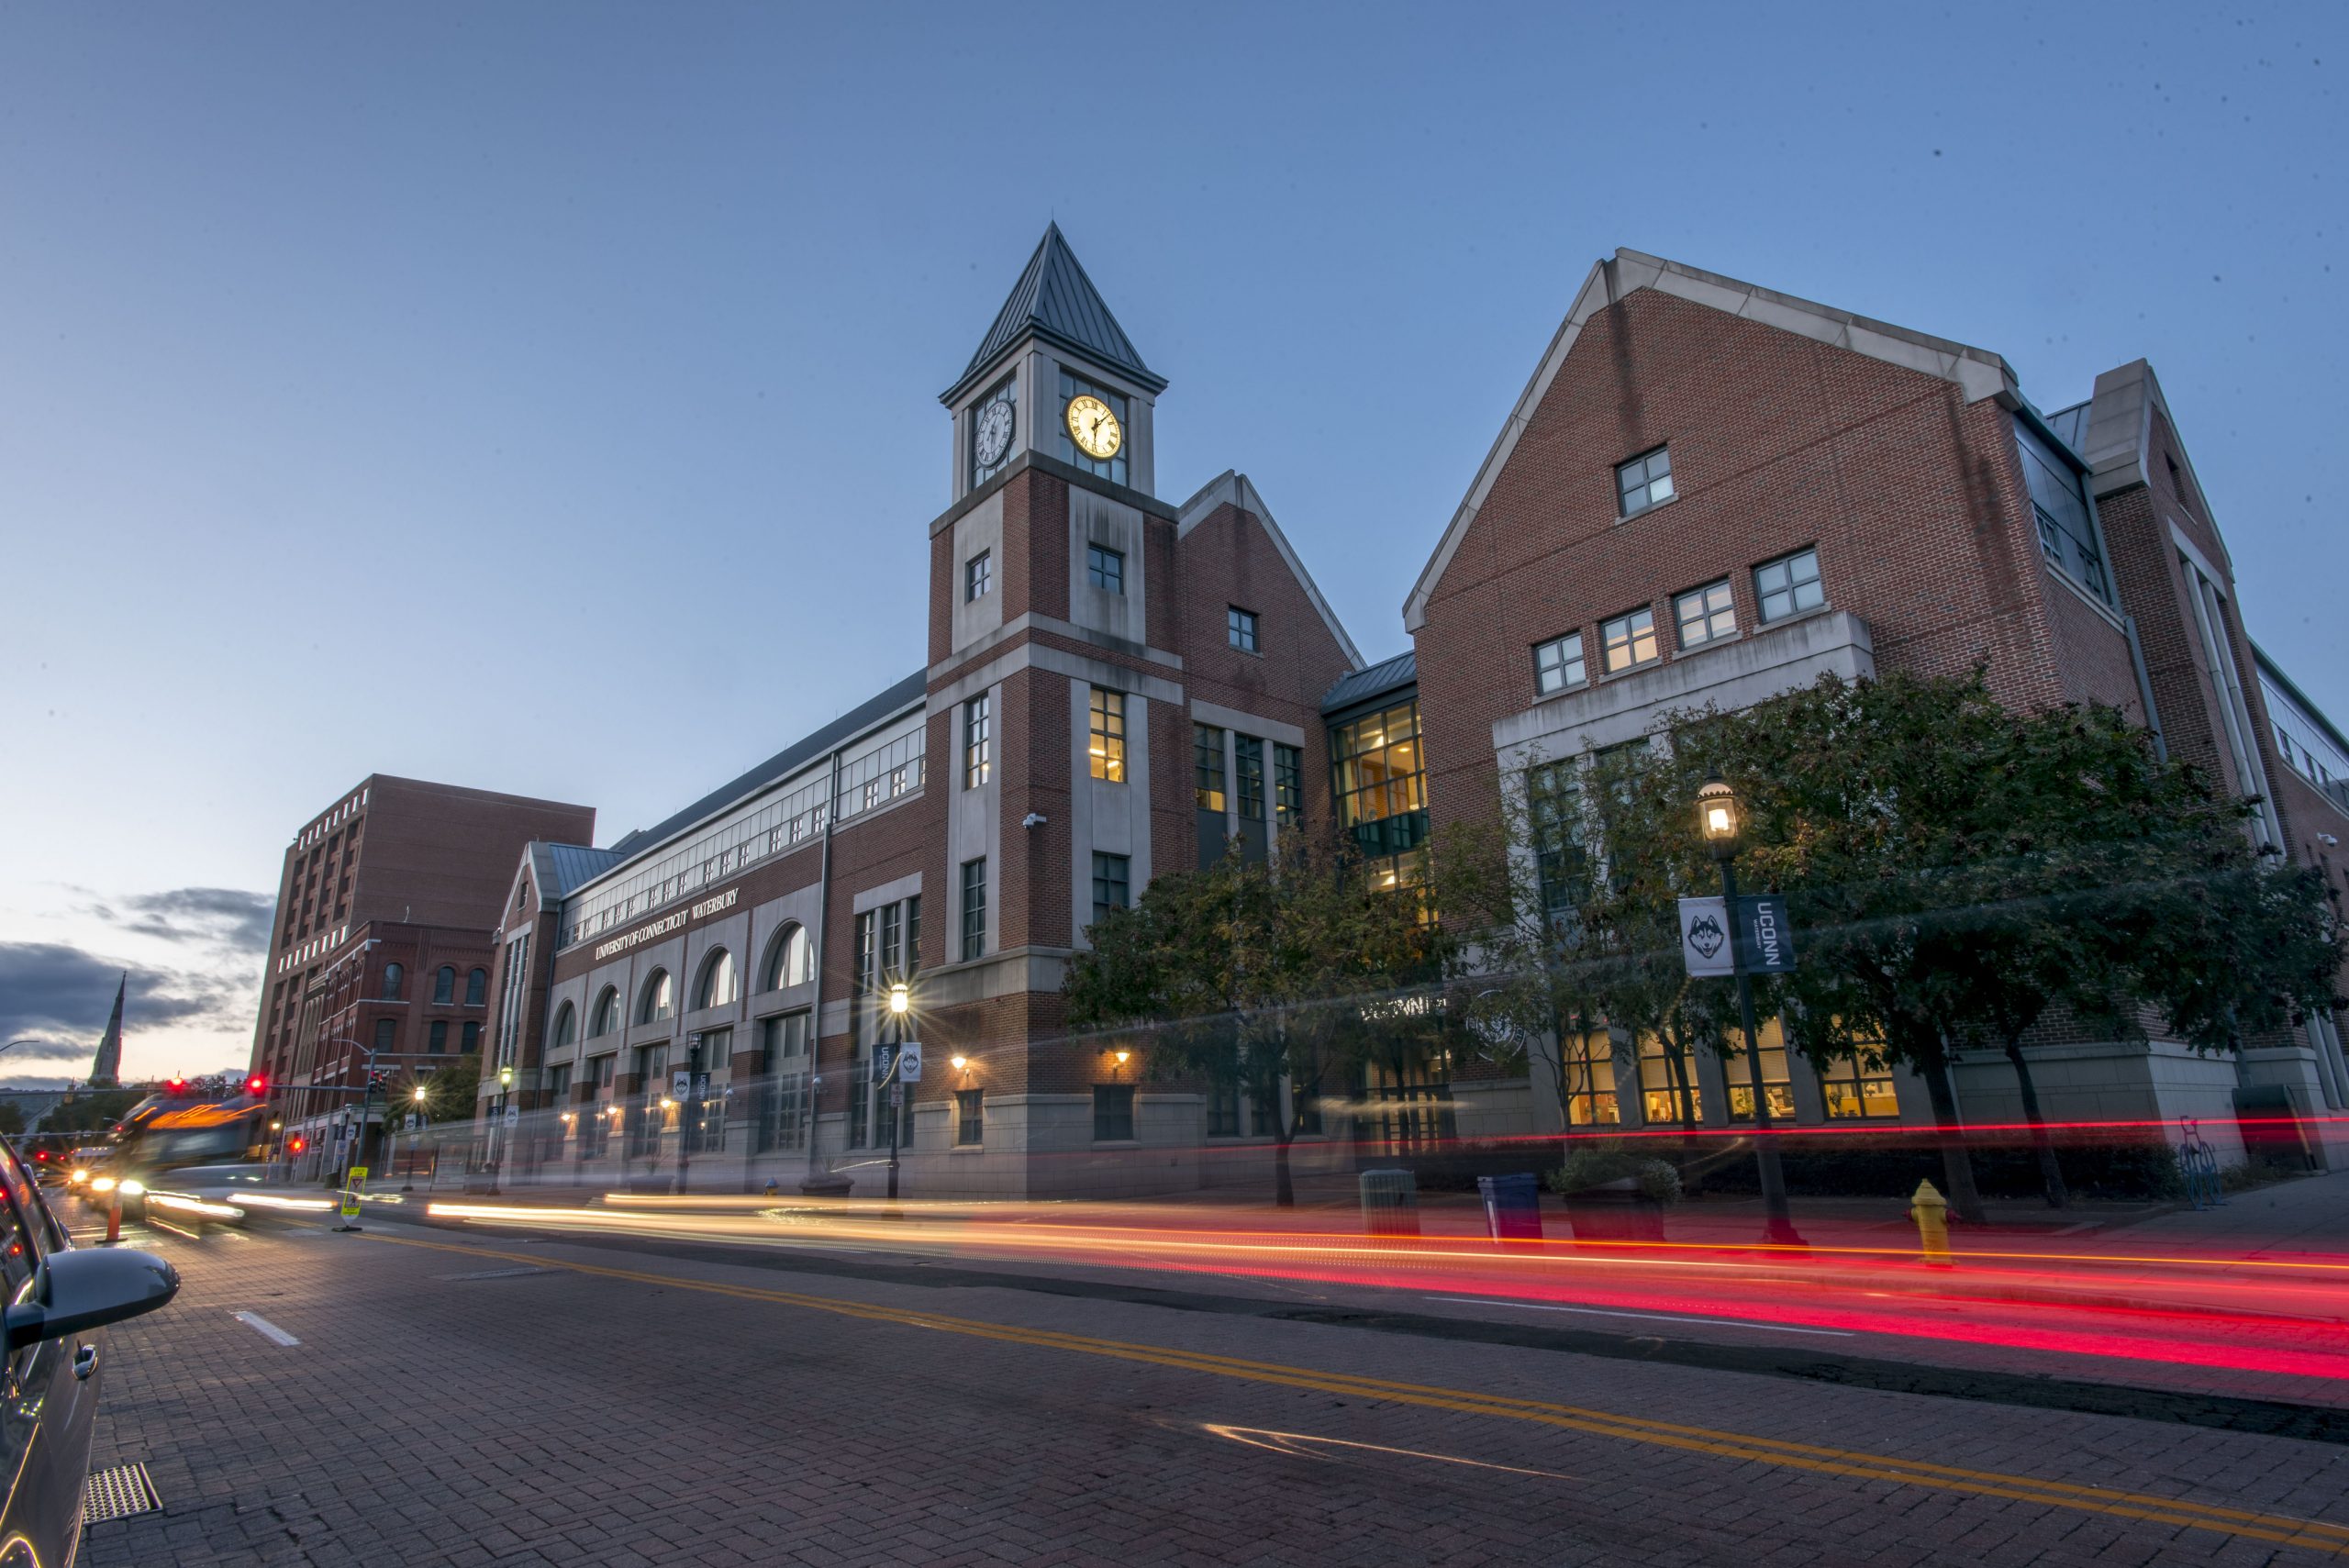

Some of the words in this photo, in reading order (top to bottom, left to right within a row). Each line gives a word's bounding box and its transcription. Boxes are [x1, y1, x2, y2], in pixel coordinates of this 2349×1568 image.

[596, 933, 631, 961] UNIVERSITY
[629, 930, 640, 947] OF
[638, 909, 689, 943] CONNECTICUT
[692, 887, 740, 921] WATERBURY
[1753, 918, 1762, 950] WATERBURY
[1757, 902, 1781, 966] UCONN
[881, 1046, 890, 1080] UCONN
[698, 1074, 707, 1101] UCONN
